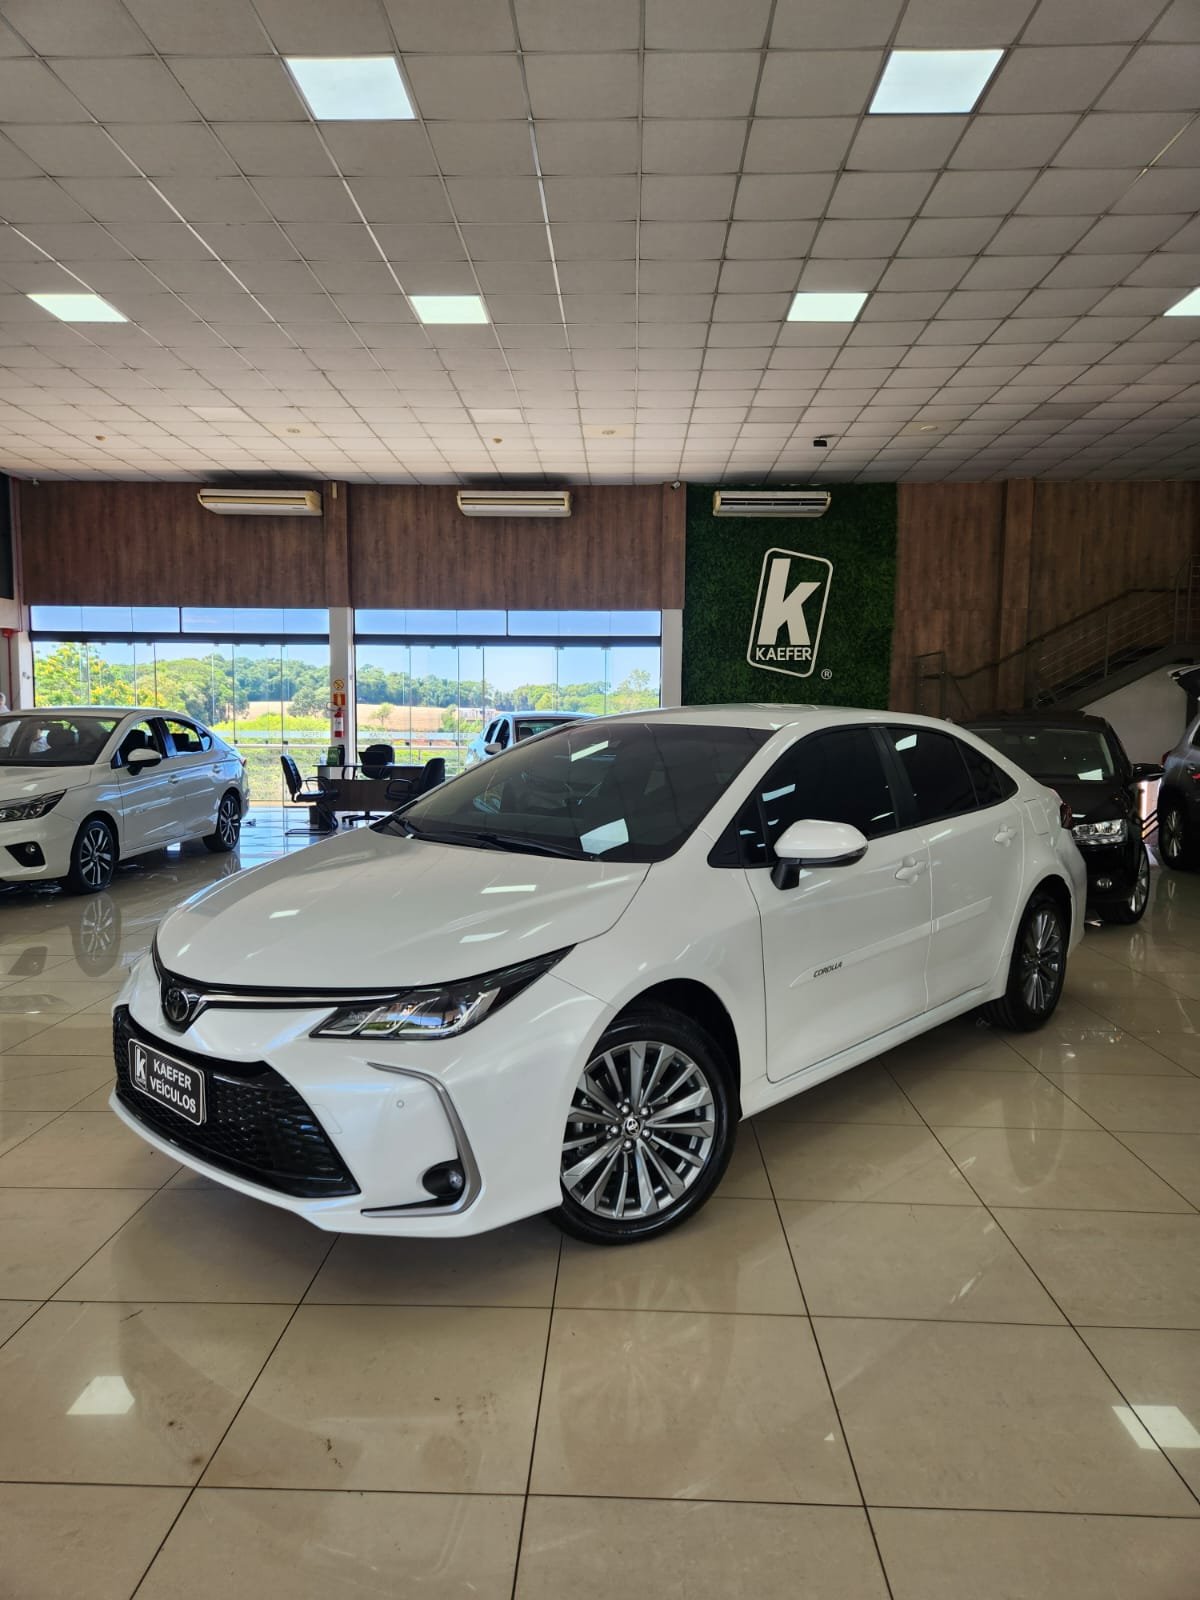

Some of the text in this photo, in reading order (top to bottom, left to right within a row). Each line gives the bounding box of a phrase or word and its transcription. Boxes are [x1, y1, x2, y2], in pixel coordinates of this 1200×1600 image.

[757, 558, 821, 645] K
[755, 647, 812, 660] KAEFER
[813, 961, 843, 978] COROLLA
[153, 1058, 192, 1092] KAEFER
[149, 1075, 197, 1114] VEÍCULOS
